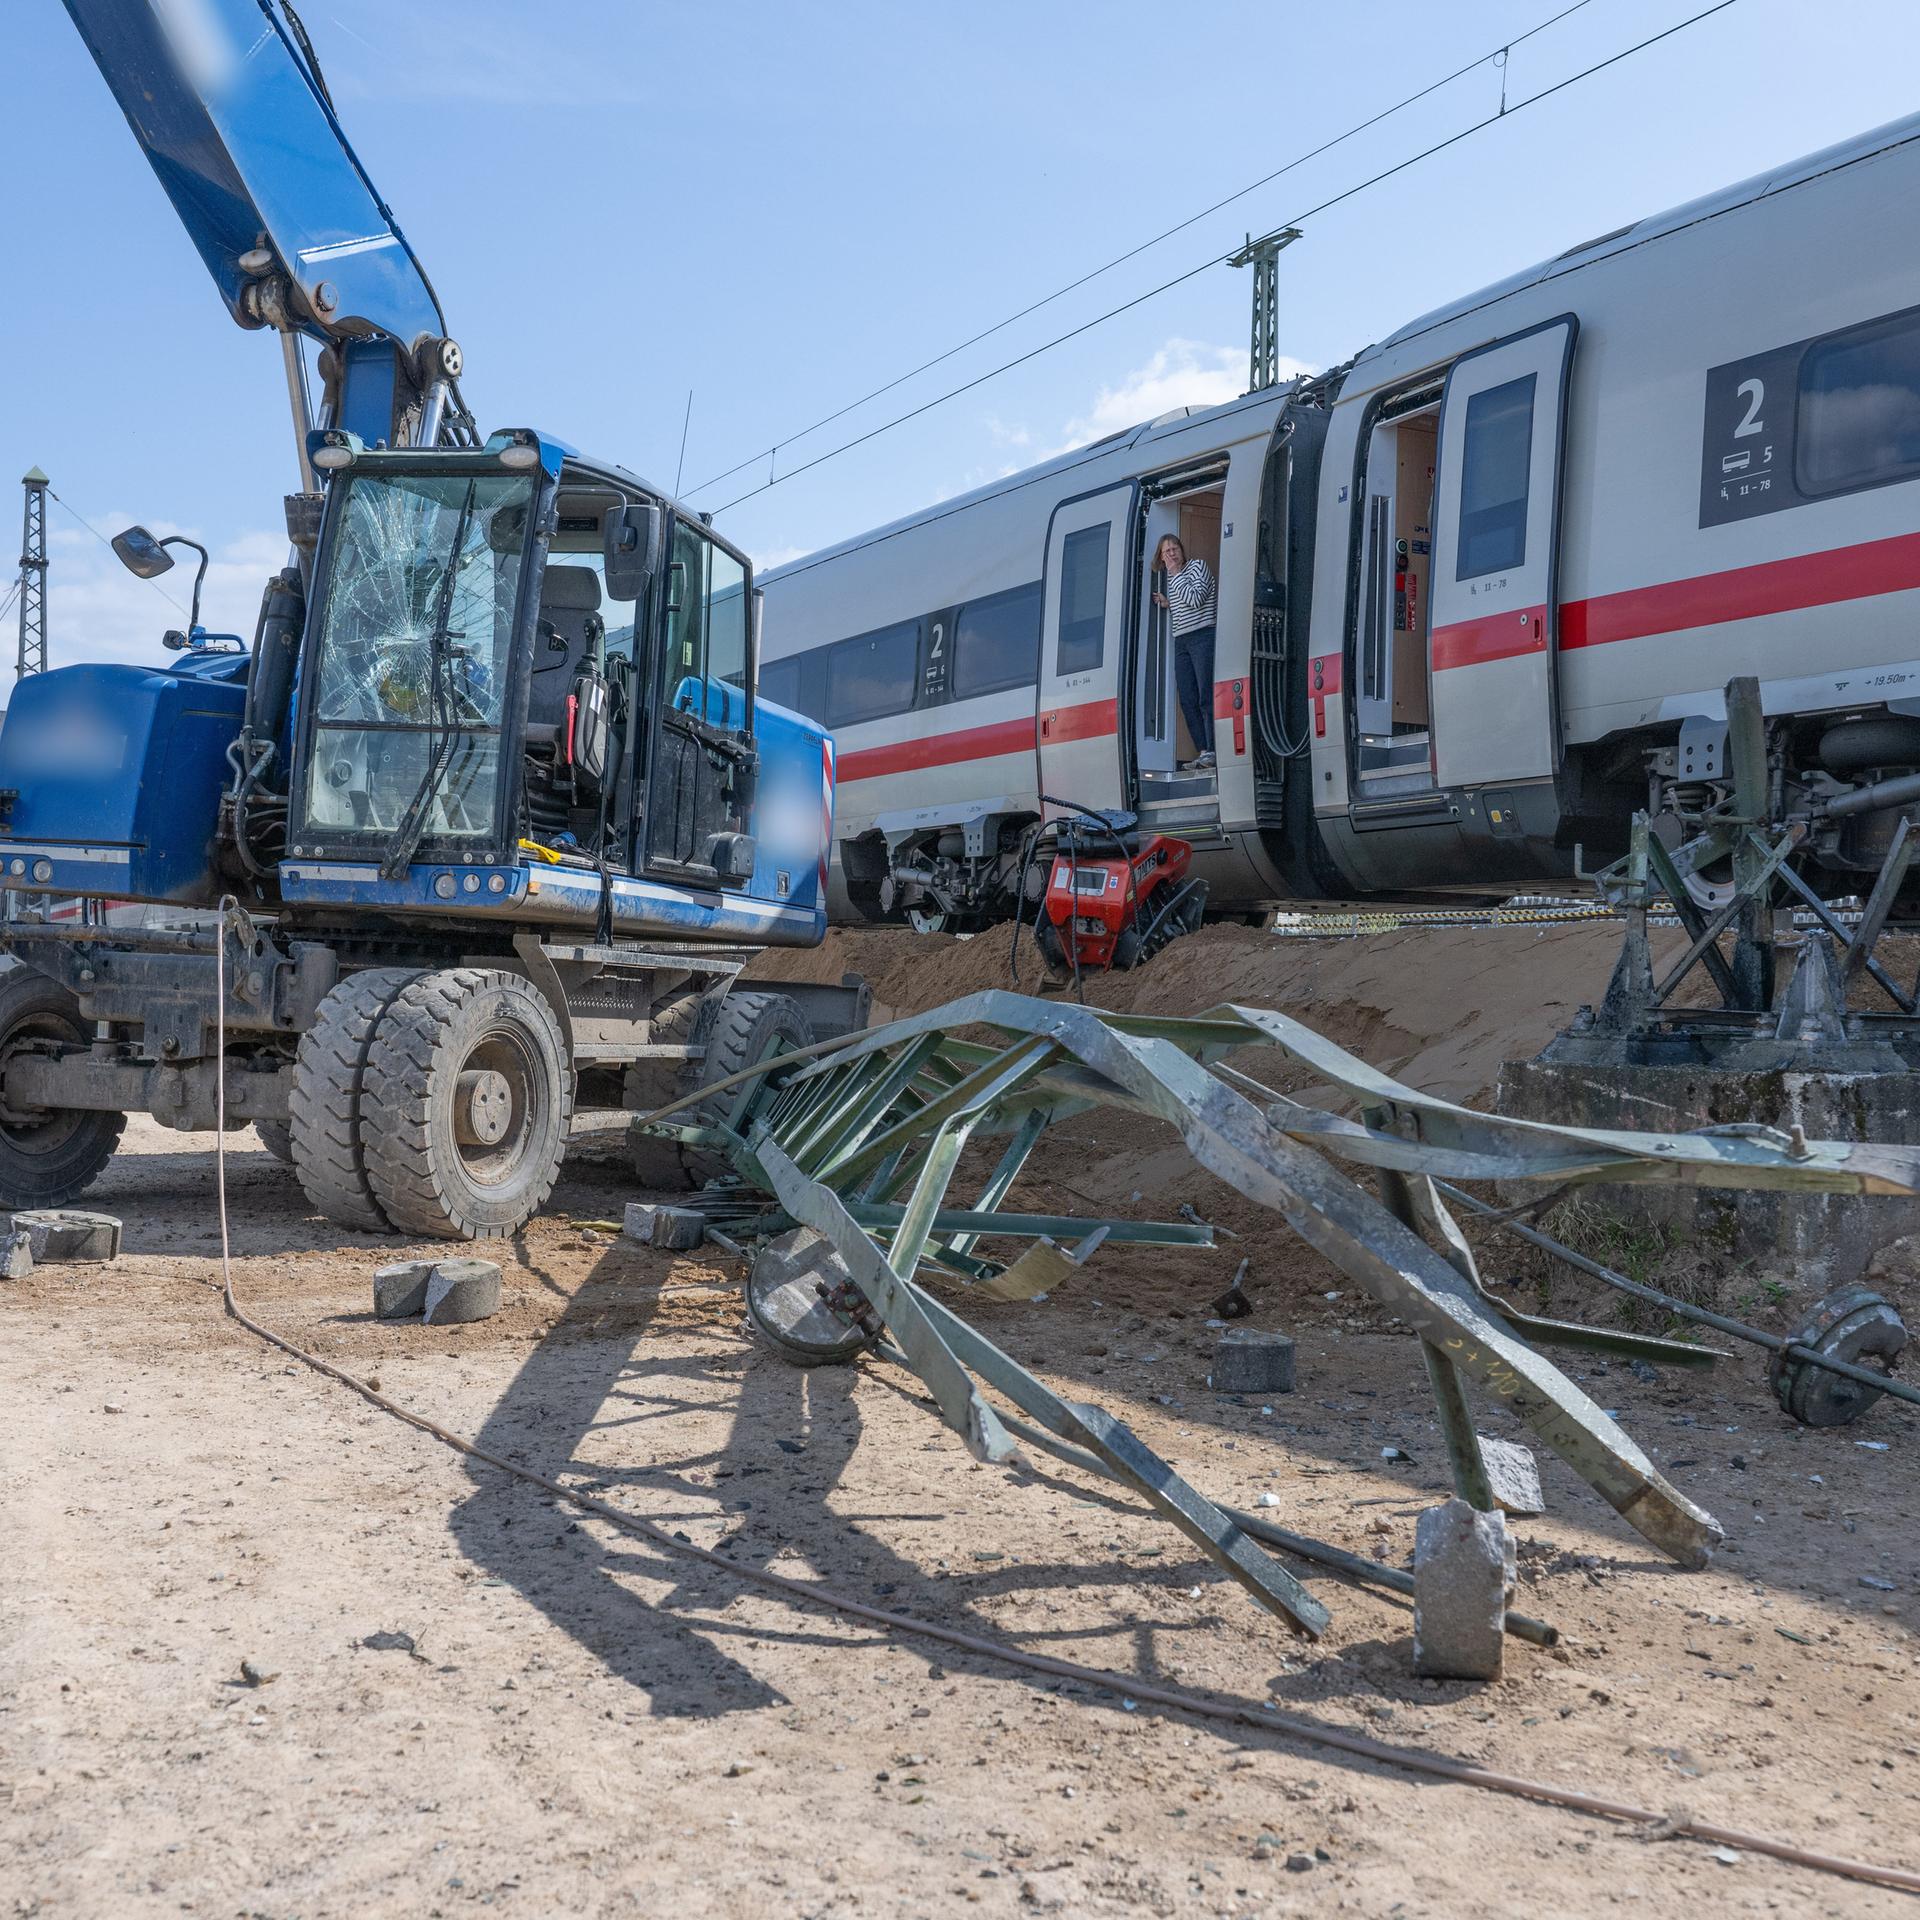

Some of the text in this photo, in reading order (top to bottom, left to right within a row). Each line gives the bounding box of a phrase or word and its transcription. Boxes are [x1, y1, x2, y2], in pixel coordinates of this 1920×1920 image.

[1734, 378, 1765, 439] 2
[1763, 445, 1773, 463] 5
[930, 623, 943, 659] 2
